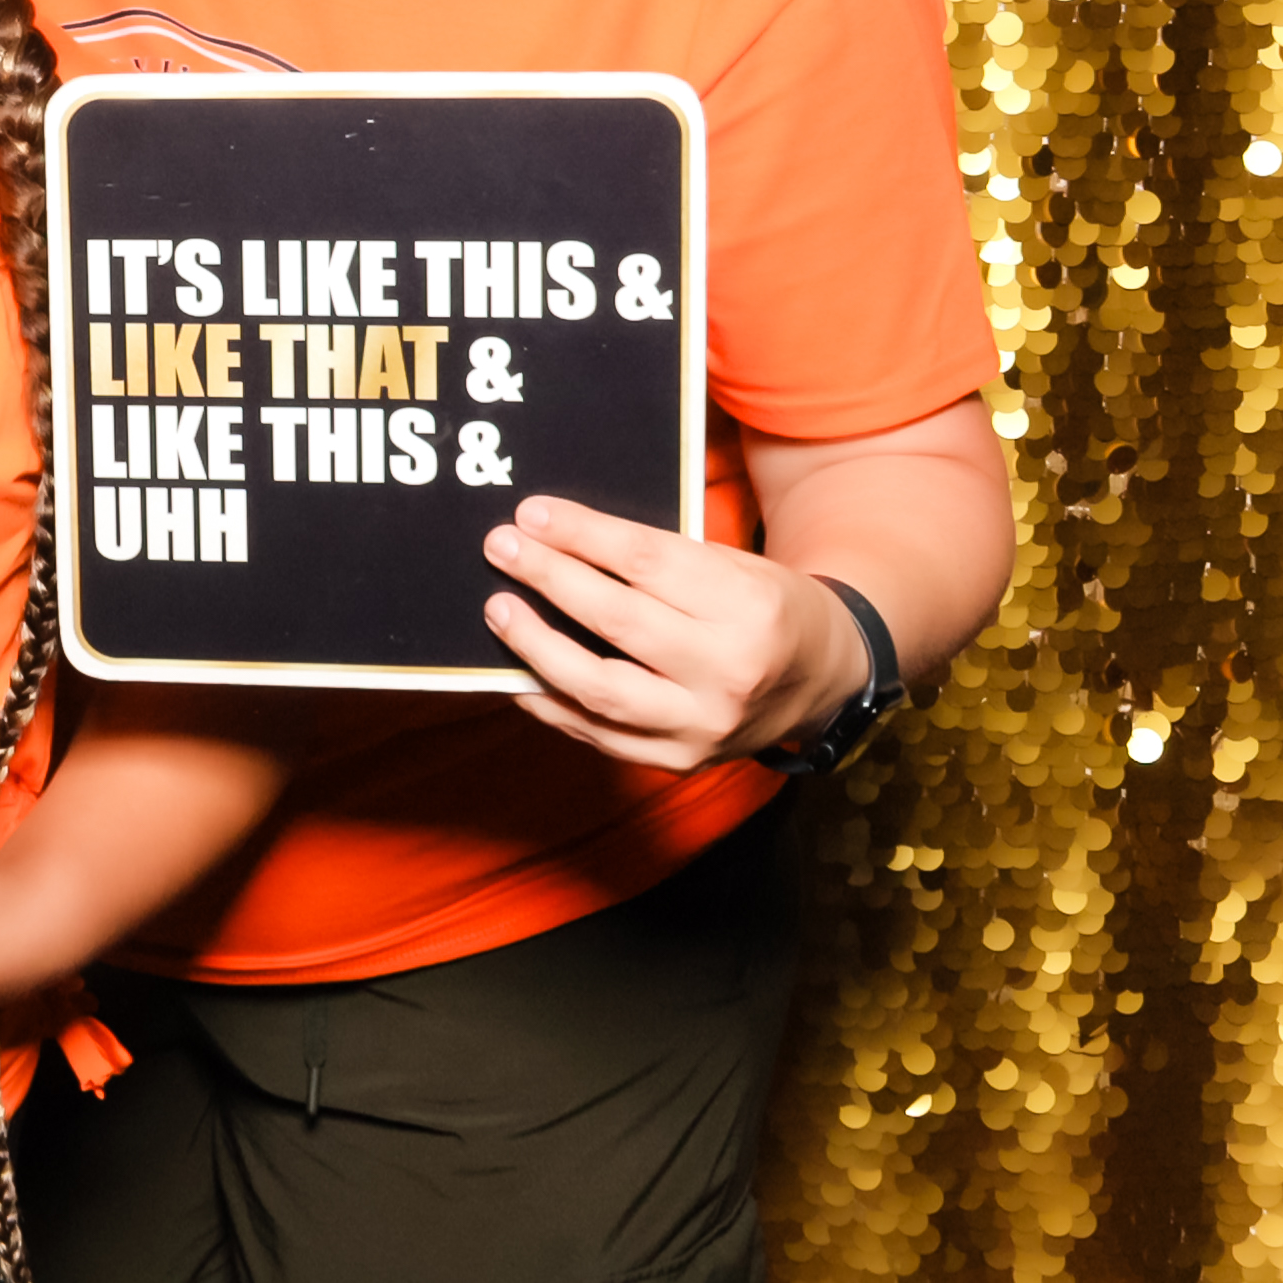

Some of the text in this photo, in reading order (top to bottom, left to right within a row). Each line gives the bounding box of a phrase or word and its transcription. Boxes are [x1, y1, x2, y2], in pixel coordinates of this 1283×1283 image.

[87, 239, 674, 322] IT'S LIKE THIS &
[90, 323, 524, 404] LIKE THAT &
[92, 405, 513, 487] LIKE THIS &
[94, 486, 249, 563] UHH
